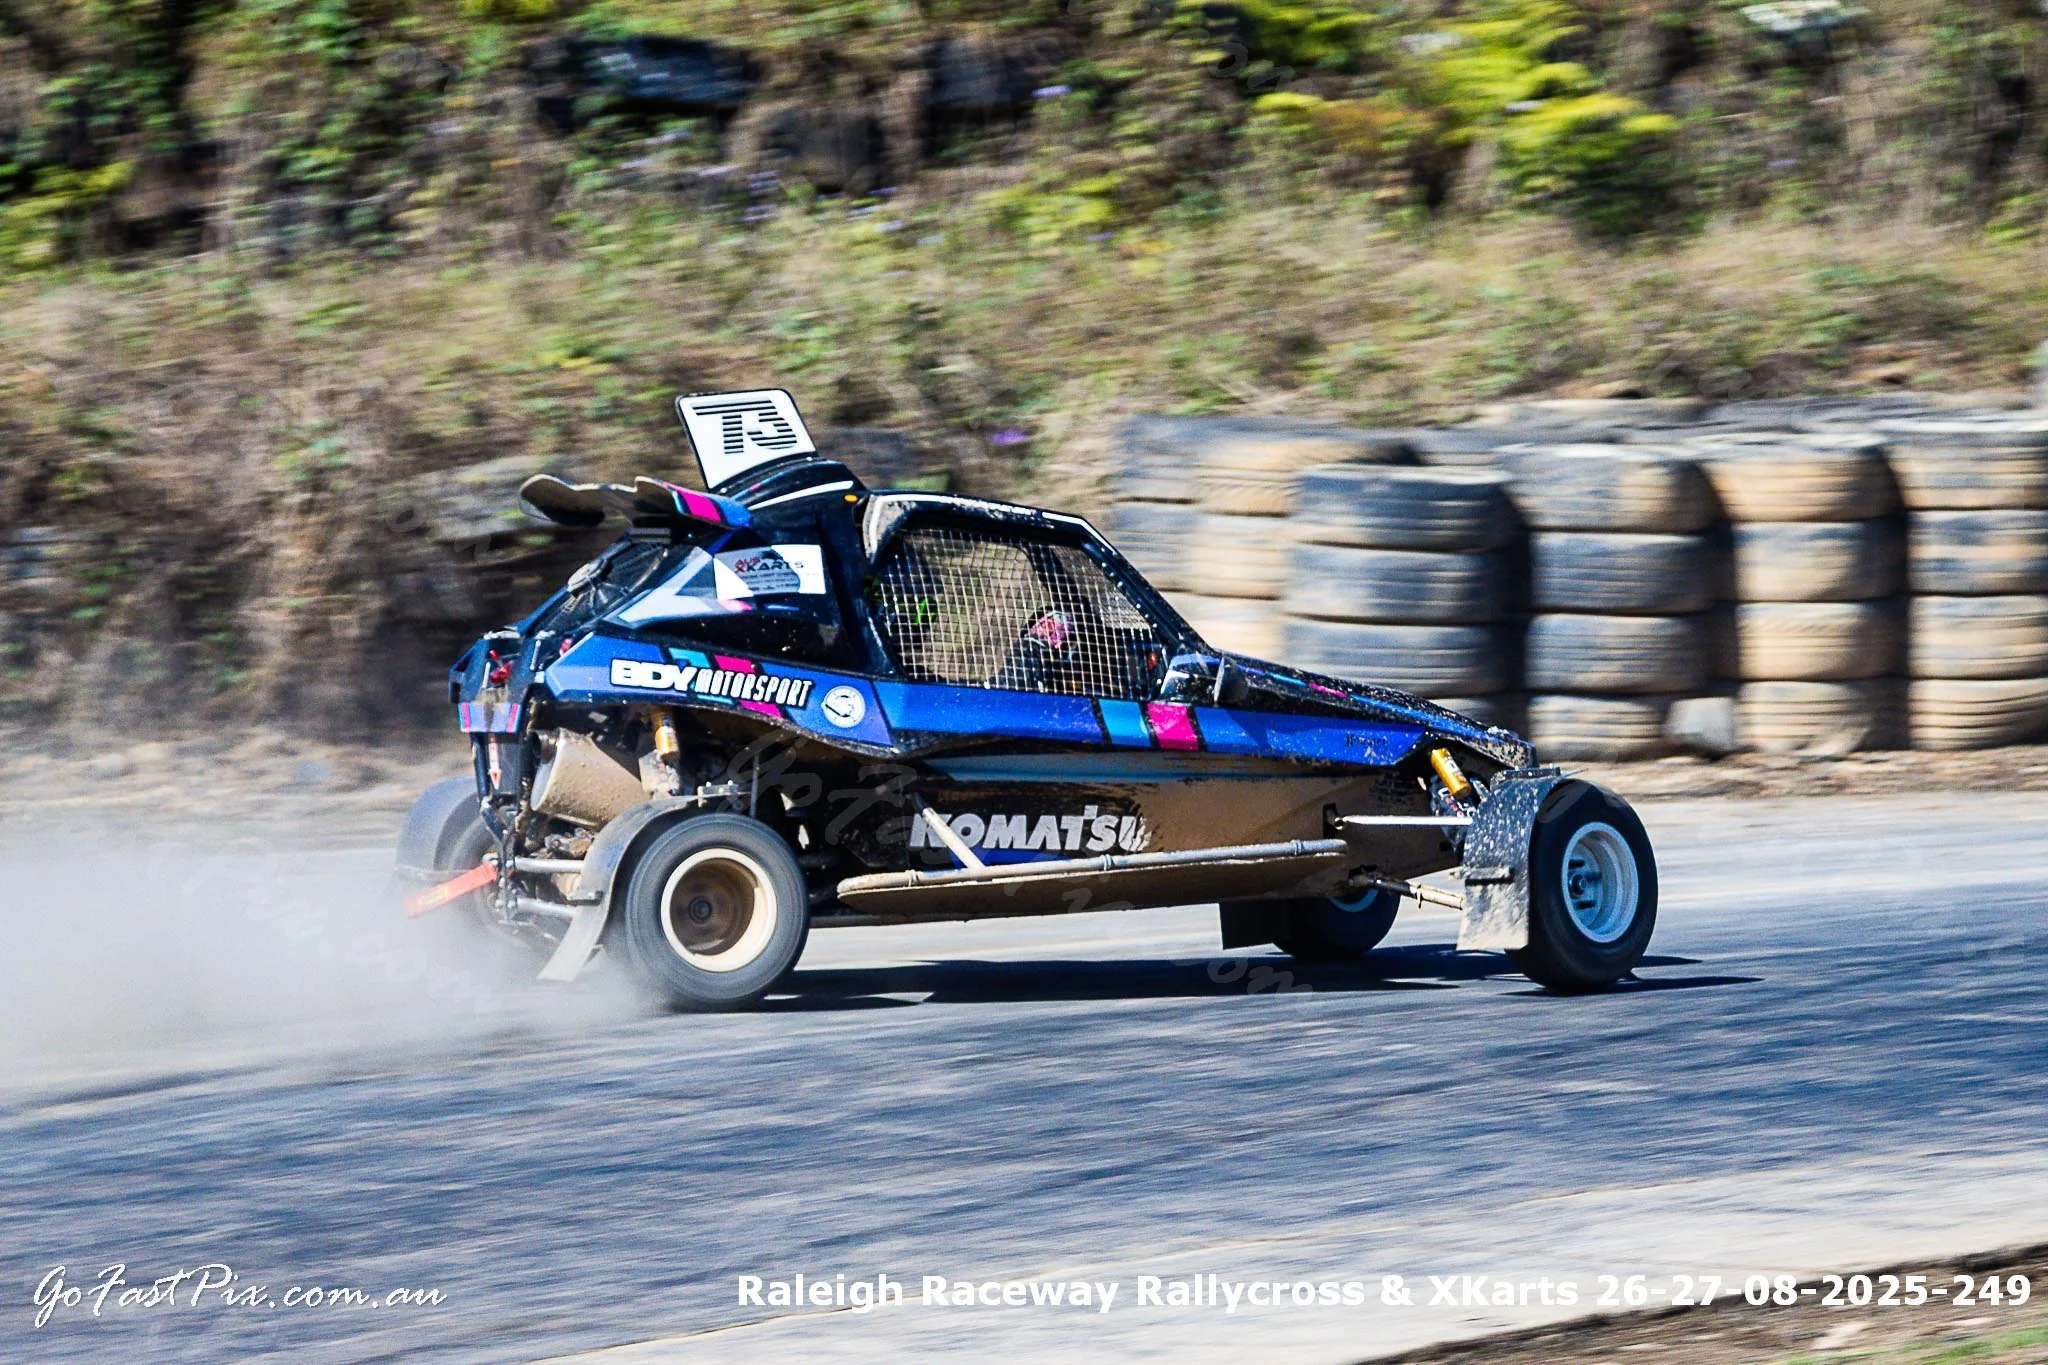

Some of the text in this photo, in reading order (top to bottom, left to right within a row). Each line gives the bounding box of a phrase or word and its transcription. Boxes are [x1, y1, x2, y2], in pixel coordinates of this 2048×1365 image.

[610, 658, 812, 707] BDY MOTORSPORT
[908, 804, 1152, 852] KOMATSU
